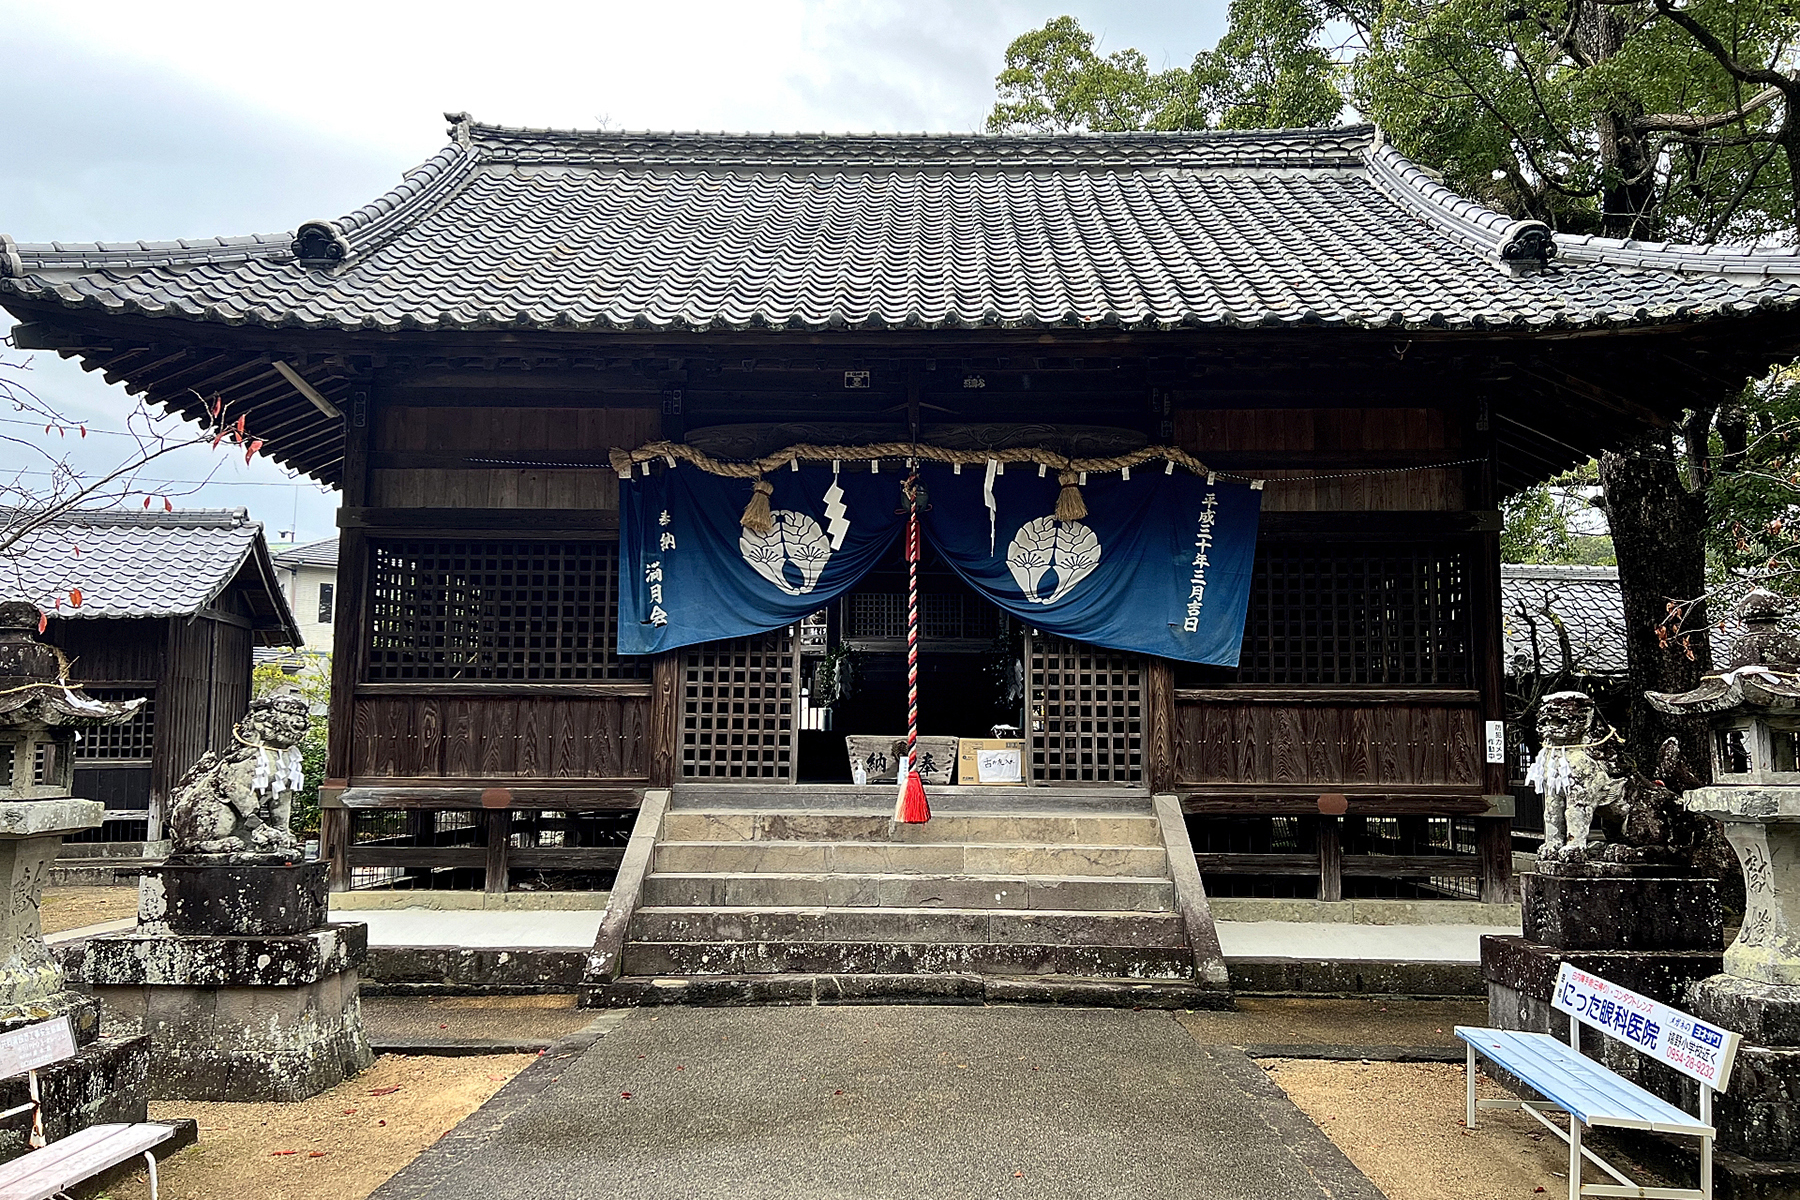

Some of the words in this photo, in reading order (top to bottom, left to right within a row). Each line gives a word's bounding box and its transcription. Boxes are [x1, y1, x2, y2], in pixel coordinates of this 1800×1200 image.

[1183, 492, 1219, 633] 平成三十年三月吉日
[1495, 724, 1503, 760] 防犯カメラ
[1561, 981, 1661, 1051] にった眼科医院
[1667, 1030, 1718, 1066] 嬉野小学校近く
[1693, 1026, 1721, 1046] ヨネザワ
[1666, 1045, 1715, 1080] 0954-28-9232
